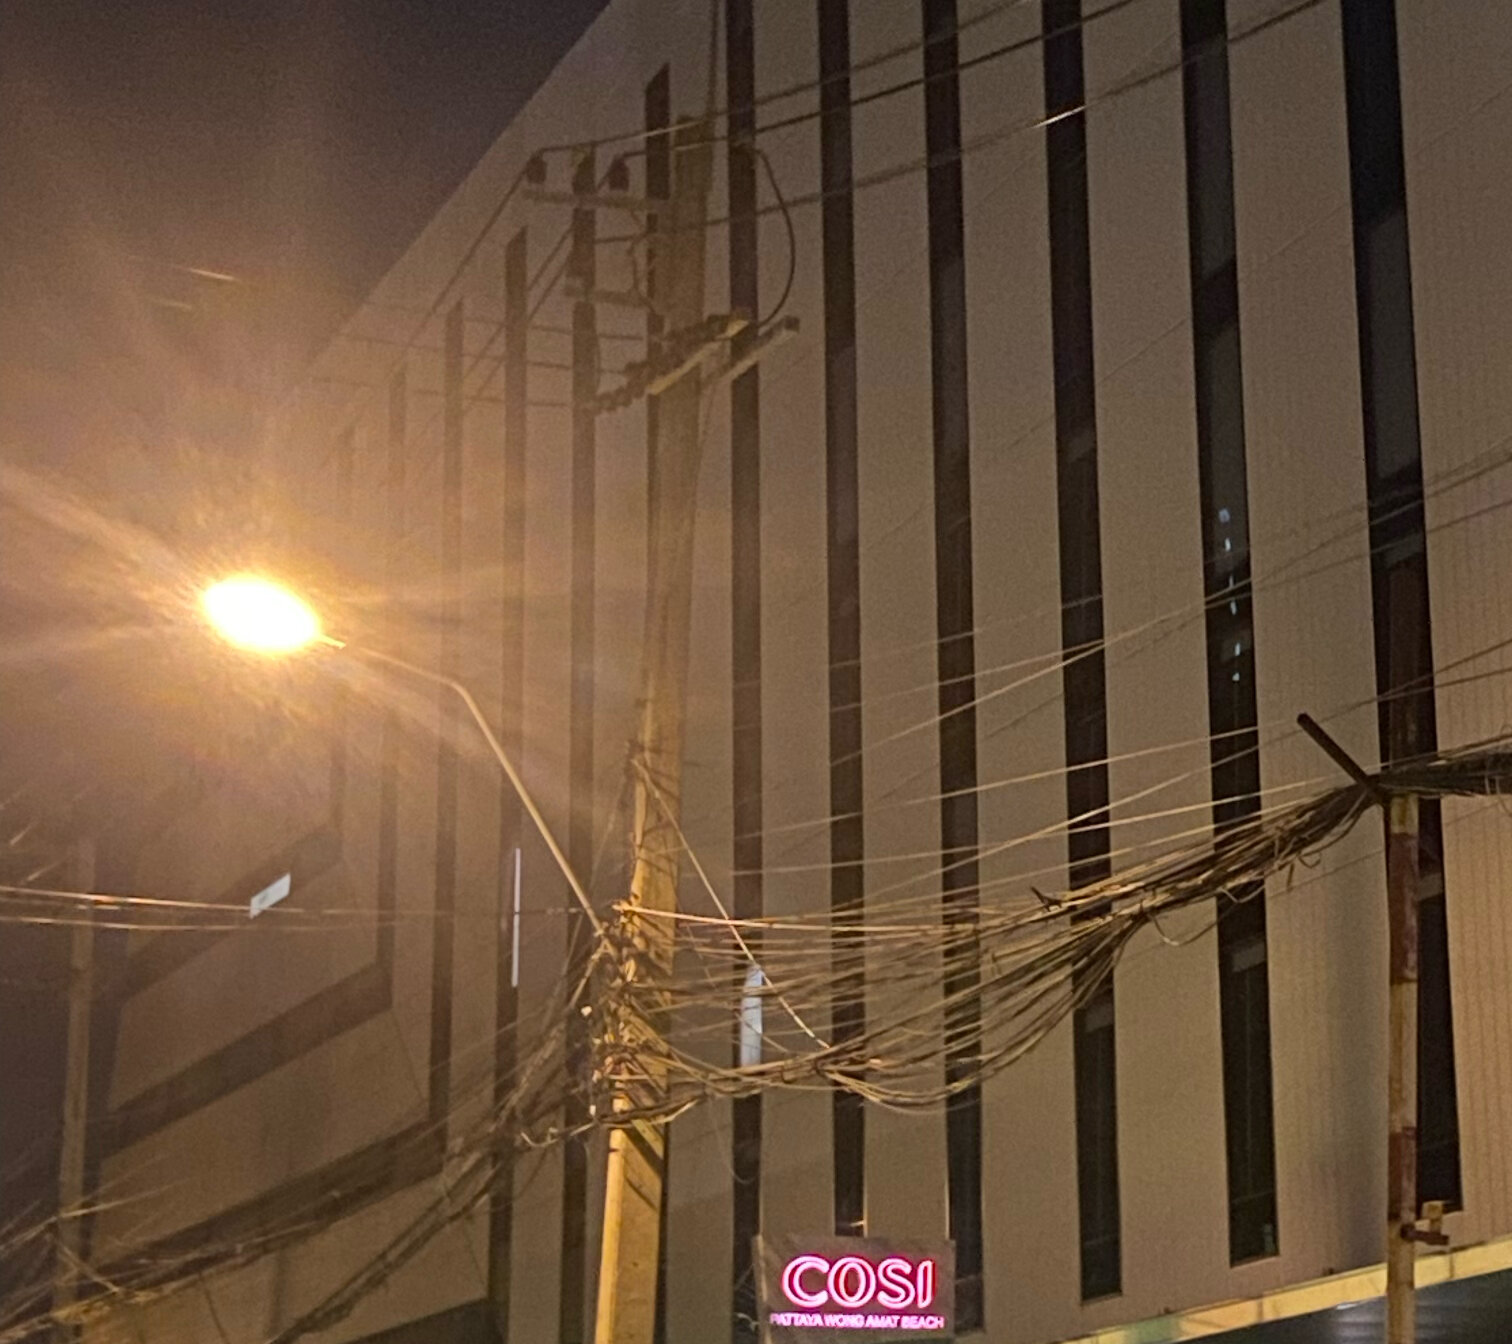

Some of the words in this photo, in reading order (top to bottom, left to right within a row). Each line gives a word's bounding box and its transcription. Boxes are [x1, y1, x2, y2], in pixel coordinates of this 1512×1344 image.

[782, 1255, 936, 1309] COSI
[769, 1312, 824, 1327] PATTAYA
[824, 1313, 865, 1328] WONG
[866, 1314, 900, 1329] AMAT
[901, 1315, 945, 1329] BEACH
